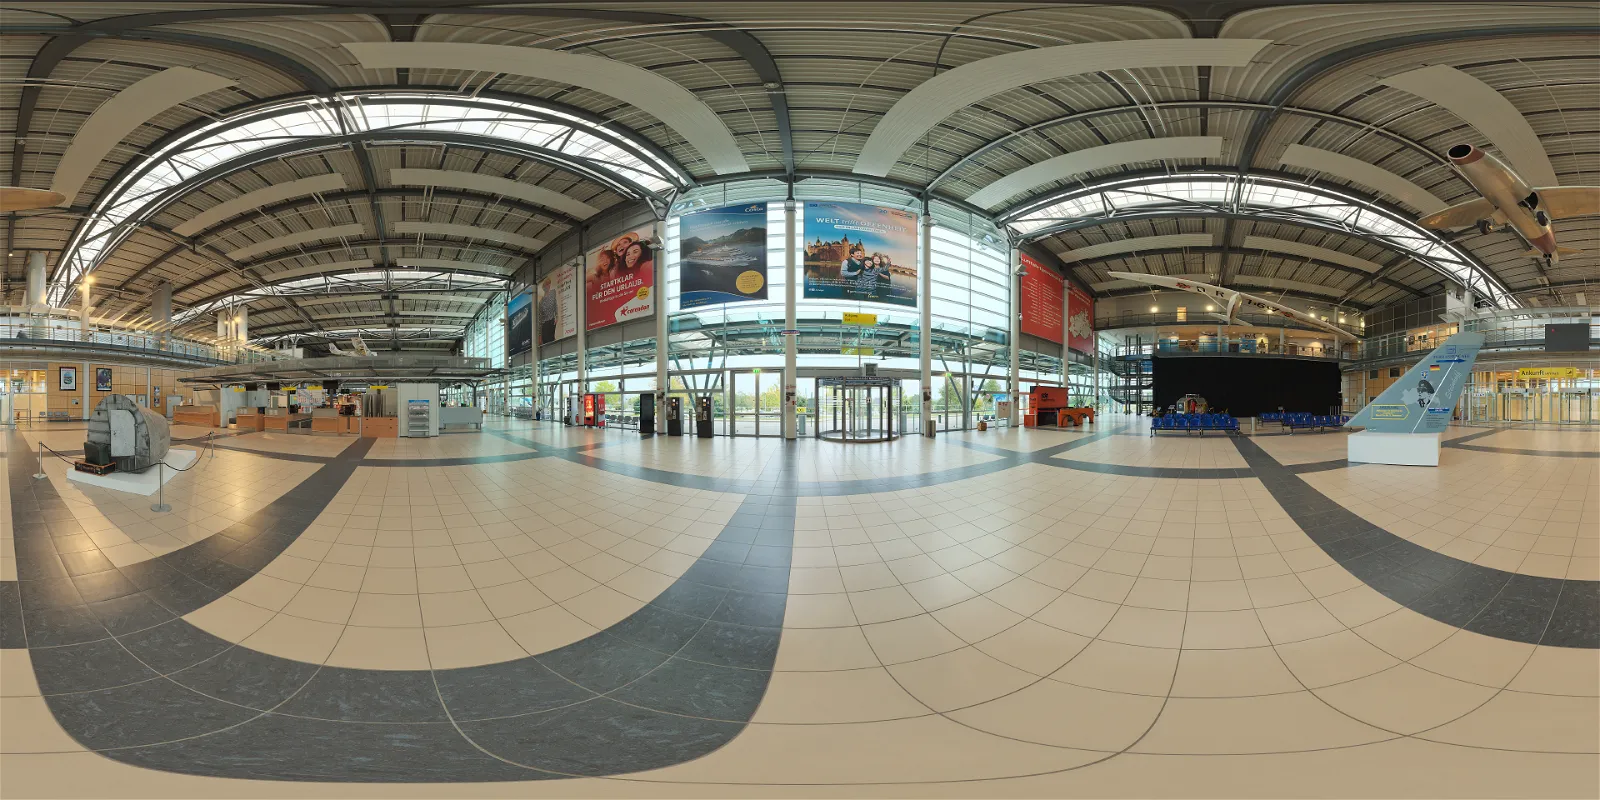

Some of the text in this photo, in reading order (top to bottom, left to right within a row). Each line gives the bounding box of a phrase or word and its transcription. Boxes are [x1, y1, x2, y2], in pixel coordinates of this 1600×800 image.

[600, 273, 634, 290] STARTKLAR
[592, 291, 603, 301] FÜR
[603, 287, 615, 297] DEN
[627, 304, 650, 315] corendon
